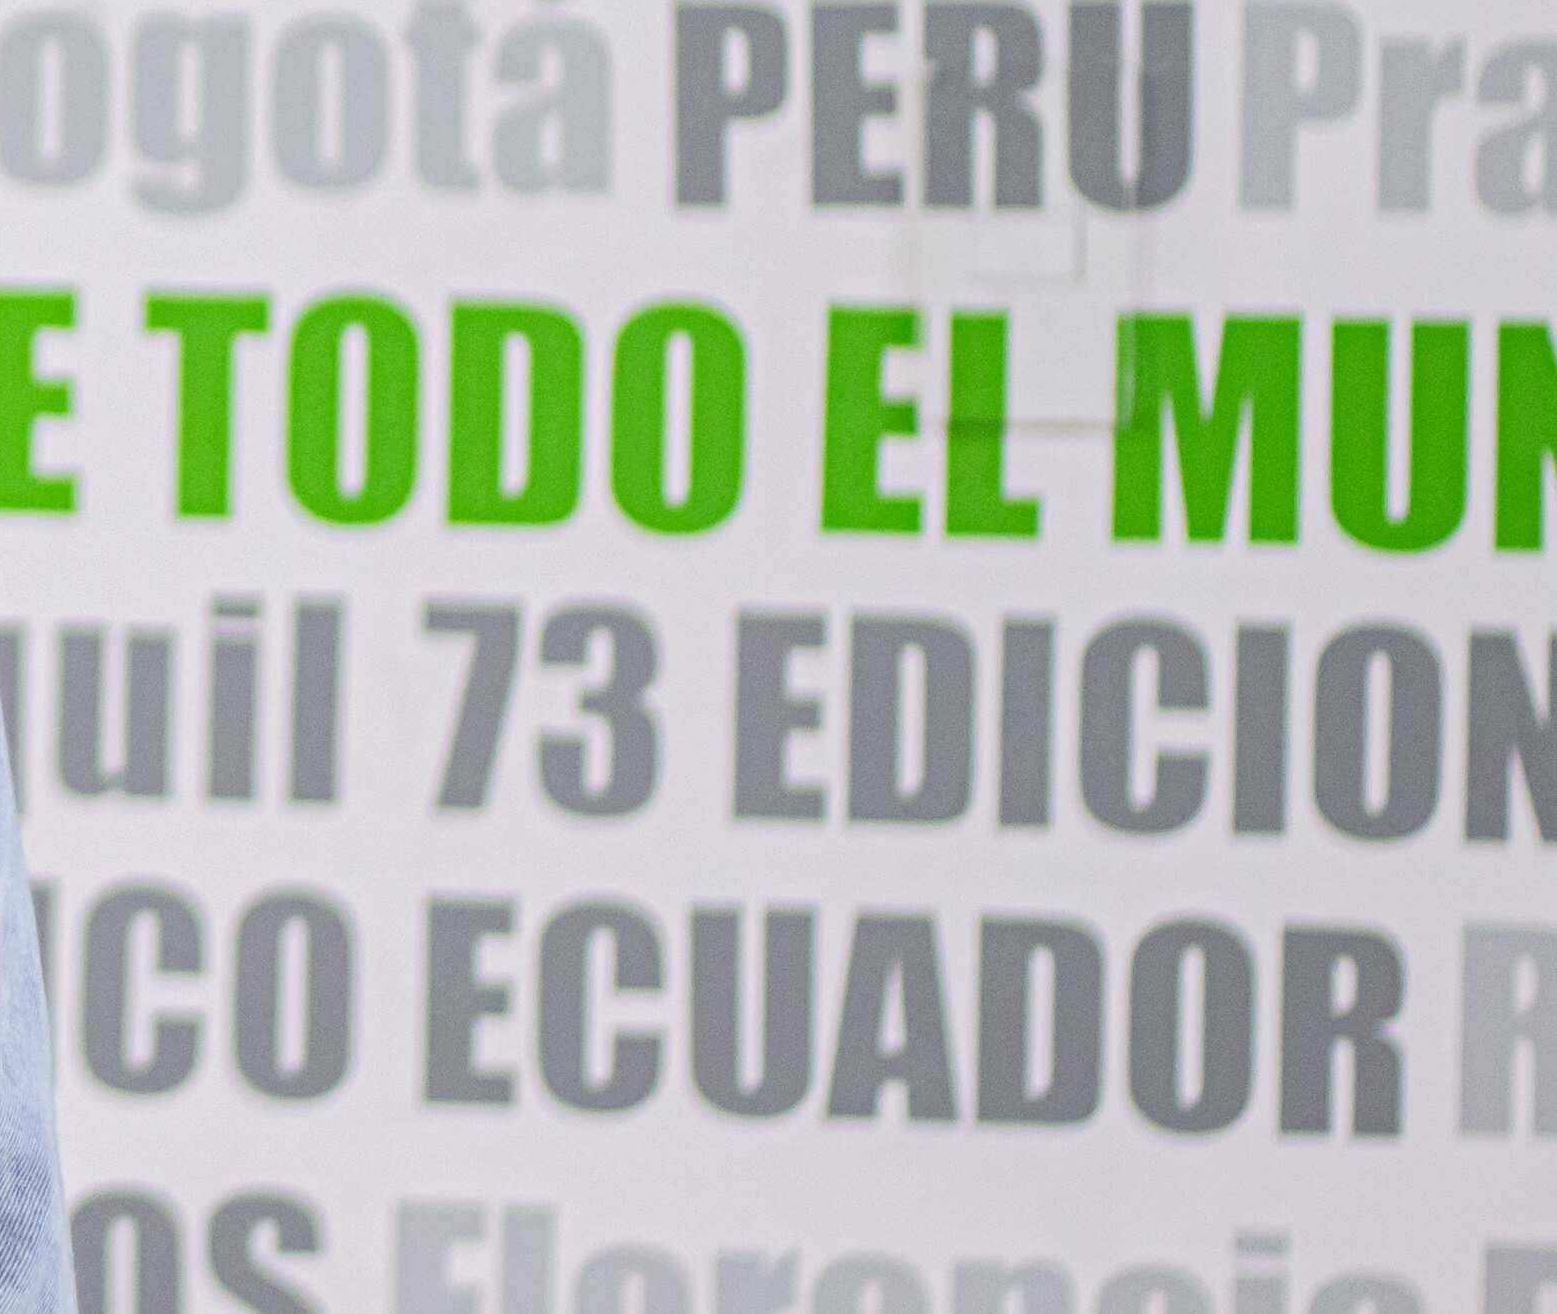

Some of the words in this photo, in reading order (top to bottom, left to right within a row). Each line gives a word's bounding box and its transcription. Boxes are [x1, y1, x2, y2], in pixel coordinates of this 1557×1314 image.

[143, 289, 748, 534] TODO
[821, 302, 1040, 538] EL
[422, 601, 665, 819] 73
[425, 894, 1407, 1141] ECUADOR
